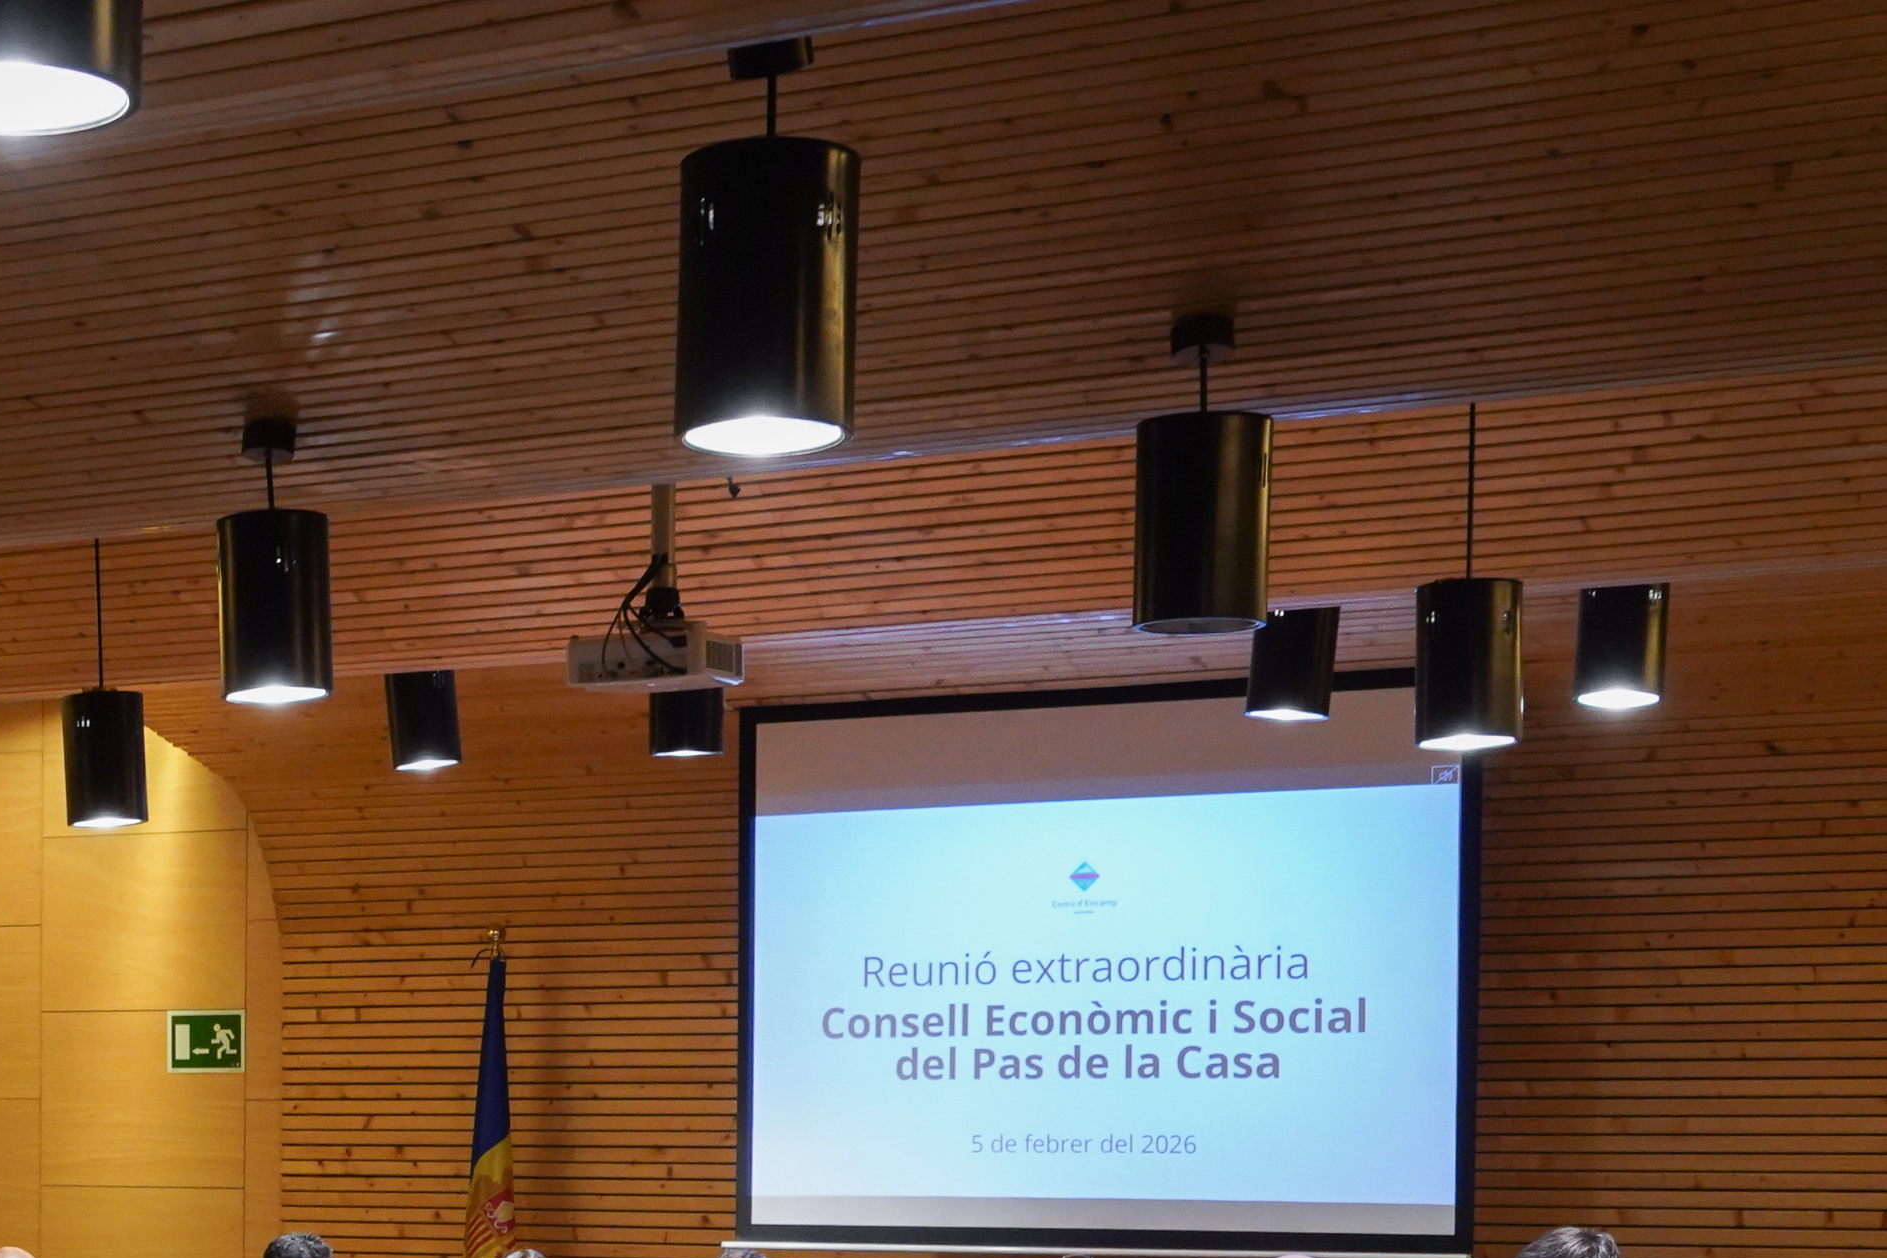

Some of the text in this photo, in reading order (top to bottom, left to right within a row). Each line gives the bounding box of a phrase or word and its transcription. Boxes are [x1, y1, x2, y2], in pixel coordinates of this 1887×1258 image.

[864, 945, 1310, 989] Reunió extraordinària
[822, 997, 1367, 1041] Consell Econòmic i Social
[896, 1044, 1281, 1082] del Pas de la Casa
[972, 1134, 1198, 1156] 5 de febrer del 2026
